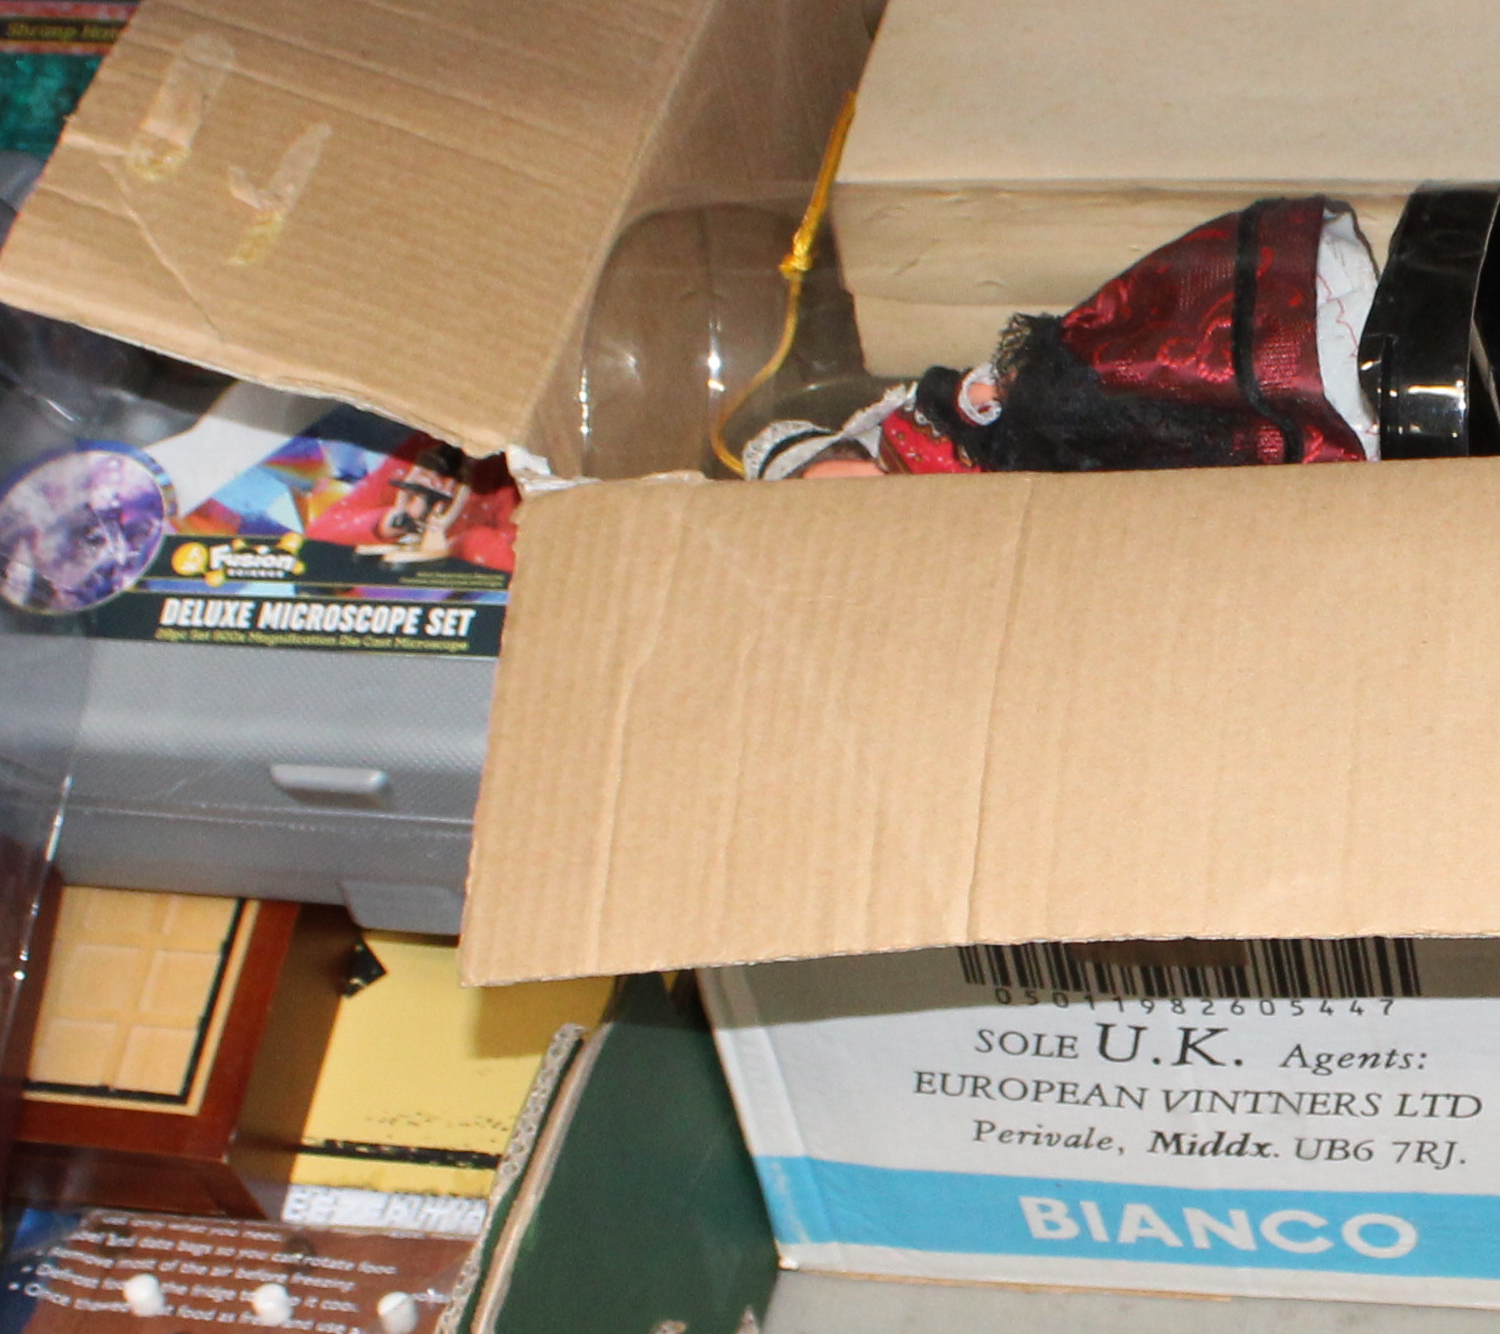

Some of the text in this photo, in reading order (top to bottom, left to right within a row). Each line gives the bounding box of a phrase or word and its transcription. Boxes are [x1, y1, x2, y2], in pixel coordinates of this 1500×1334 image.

[209, 543, 297, 570] Fusion
[159, 597, 476, 637] DELUXE MICROSCOPE SET
[974, 1021, 1429, 1077] SOLE U.K. Agents:
[912, 1070, 1483, 1119] EUROPEAN VINTNERS LTD
[971, 1118, 1467, 1170] Perivale, Middx. UB6 7RJ.
[1018, 1194, 1418, 1260] BIANCO
[158, 1259, 180, 1272] of
[179, 1262, 209, 1275] the
